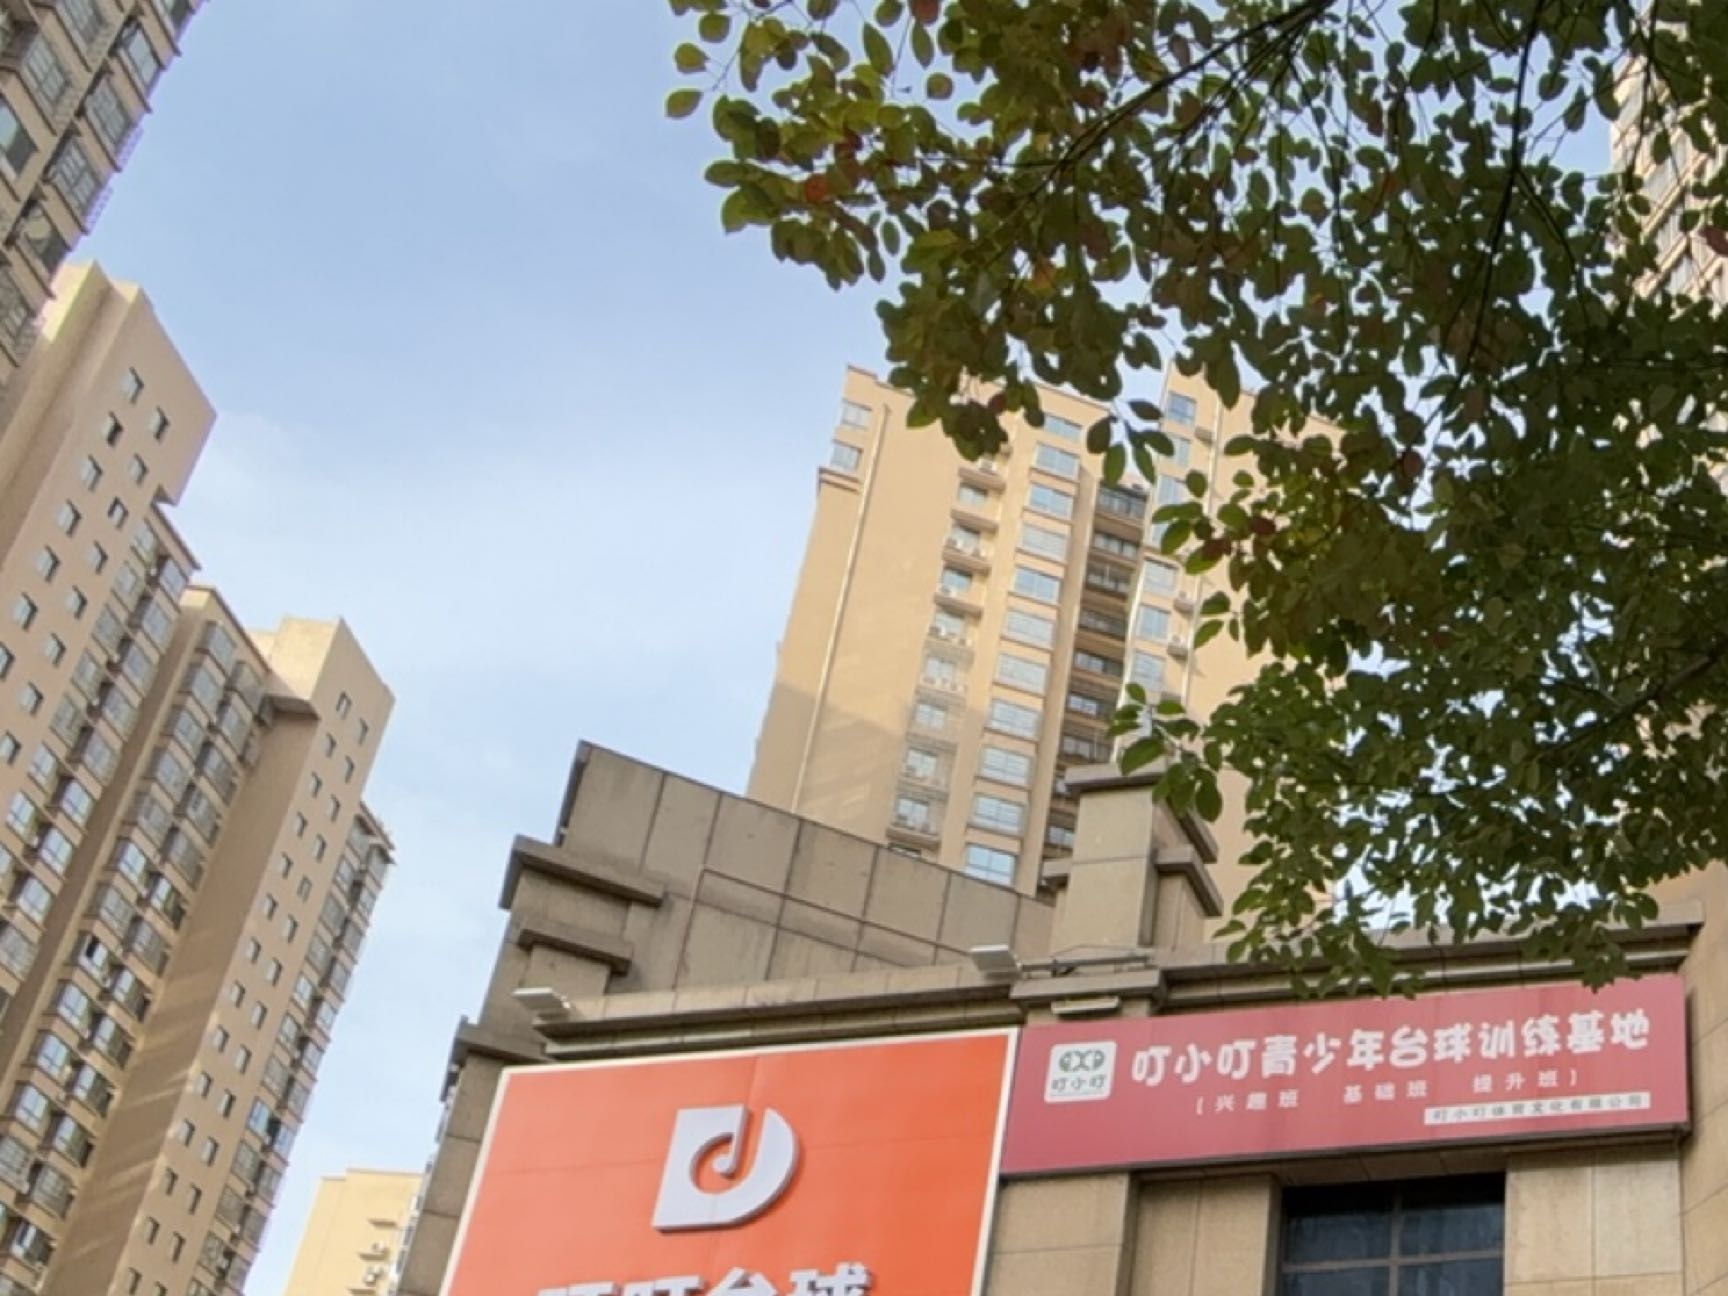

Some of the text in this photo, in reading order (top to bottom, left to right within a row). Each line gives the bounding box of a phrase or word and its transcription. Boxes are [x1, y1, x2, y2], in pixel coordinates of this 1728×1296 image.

[1131, 1008, 1650, 1086] 叮小叮青少年台球训练基地
